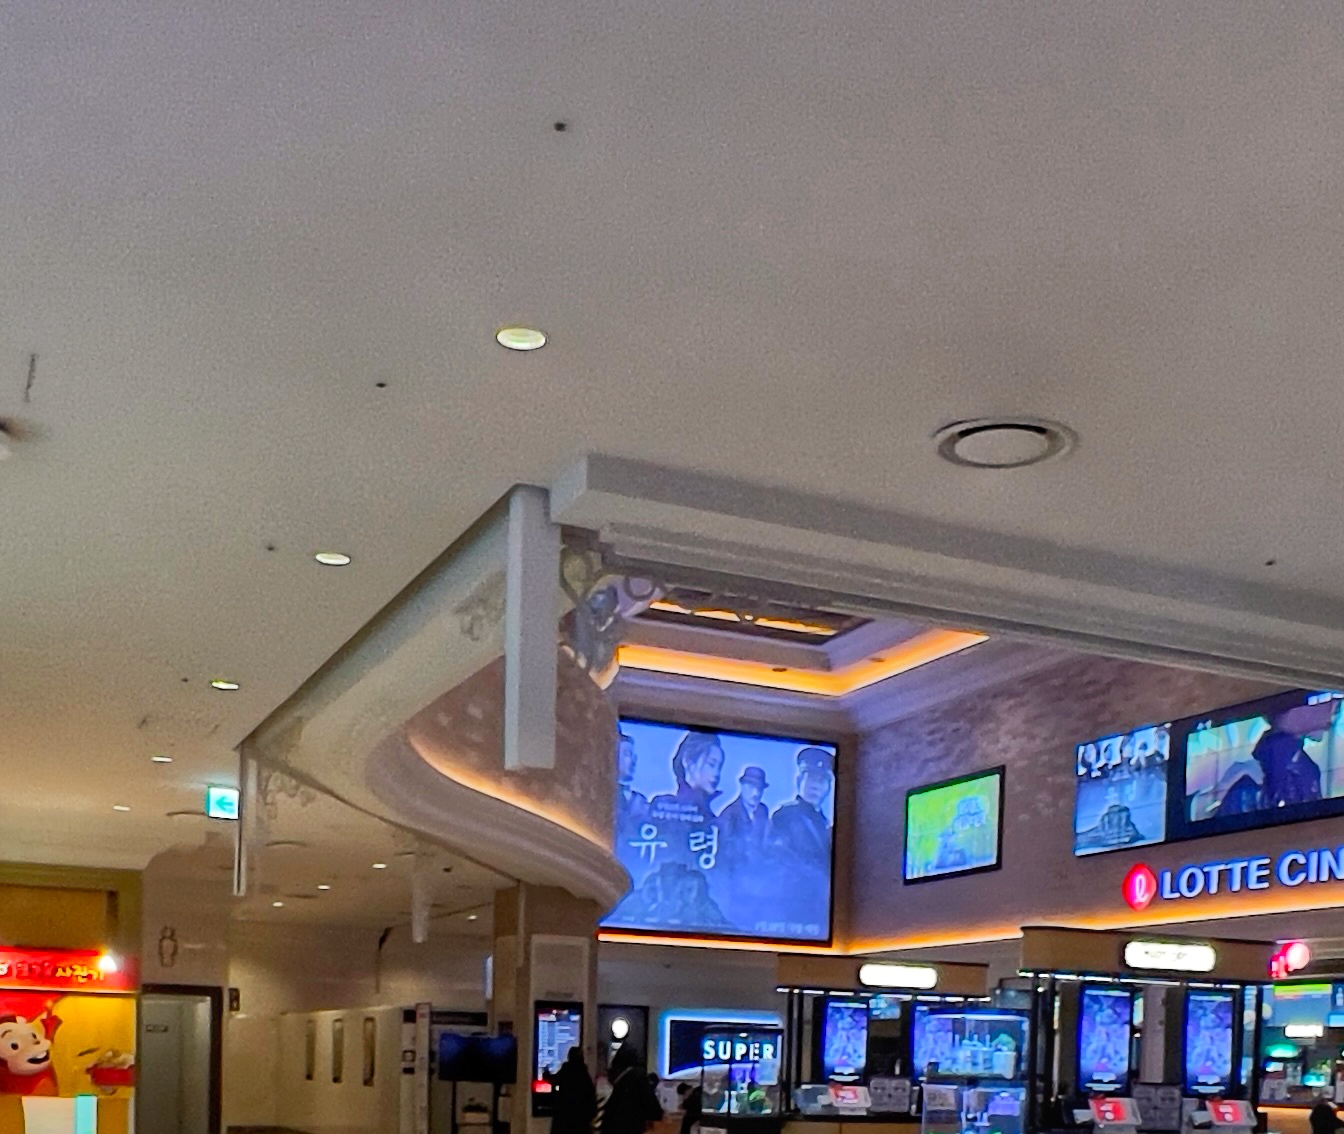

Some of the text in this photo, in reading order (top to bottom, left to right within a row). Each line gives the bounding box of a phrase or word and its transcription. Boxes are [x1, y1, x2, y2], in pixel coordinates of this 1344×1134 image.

[628, 823, 720, 870] 유령
[1161, 856, 1272, 901] LOTTE
[703, 1038, 775, 1061] SUPER
